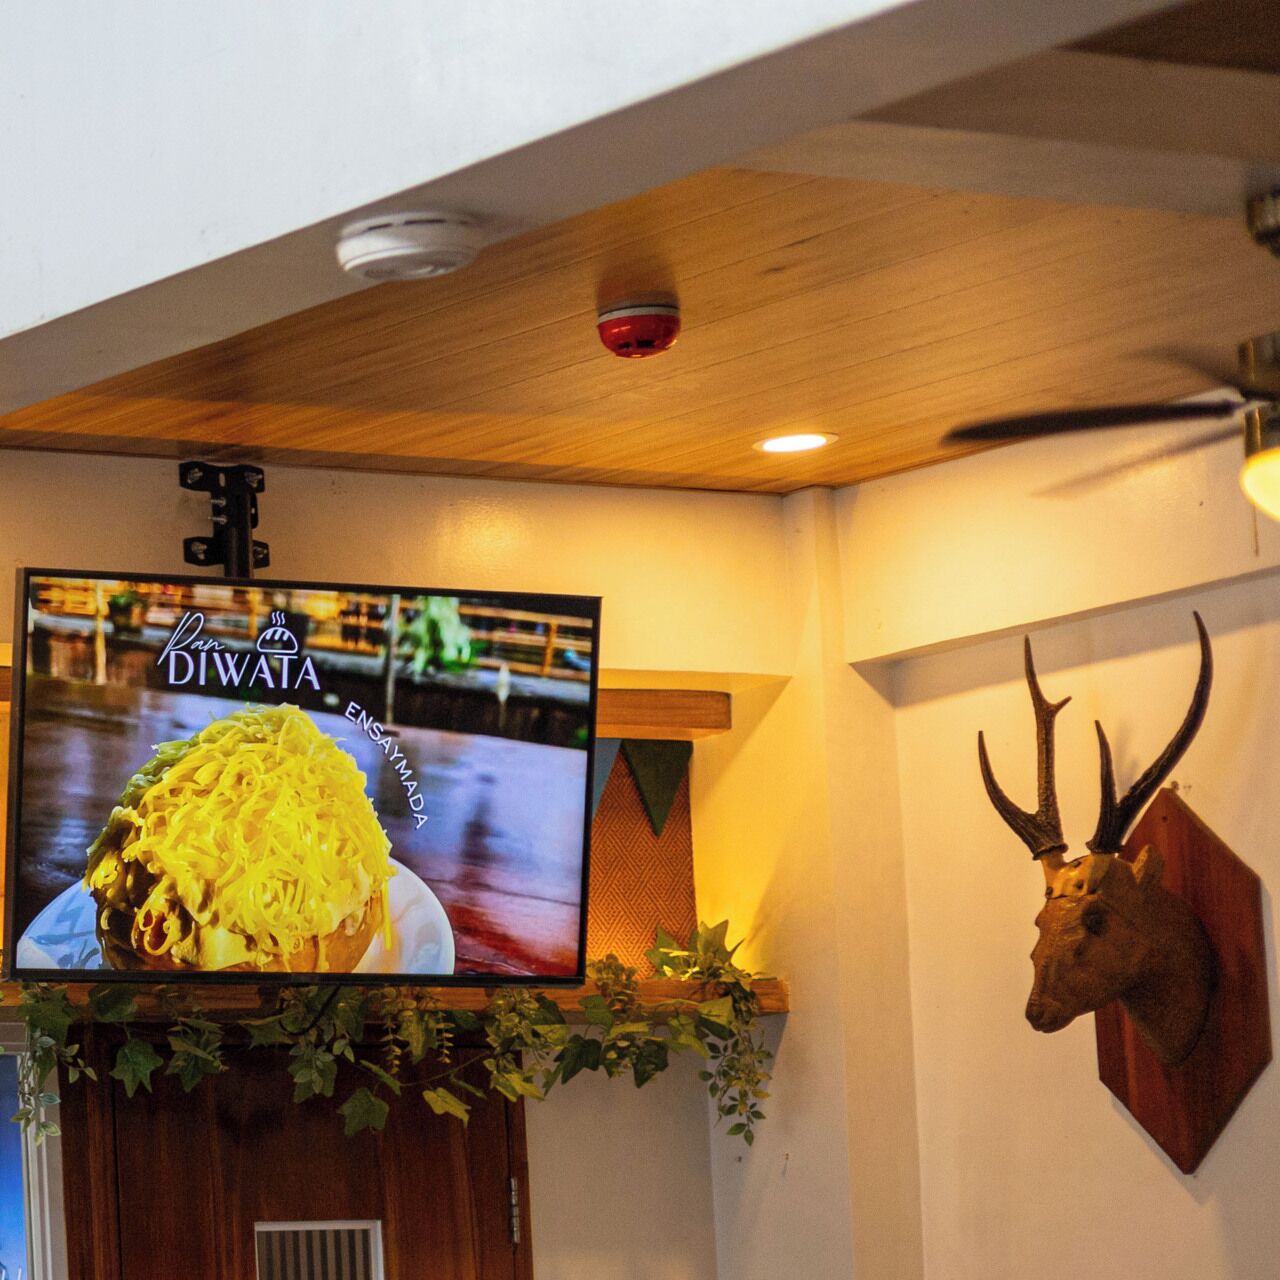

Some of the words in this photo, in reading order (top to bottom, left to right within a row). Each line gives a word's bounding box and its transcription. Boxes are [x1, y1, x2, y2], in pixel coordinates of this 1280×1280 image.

[157, 611, 224, 666] Pan
[168, 650, 321, 691] DIWATA
[344, 701, 429, 830] ENSAYMADA
